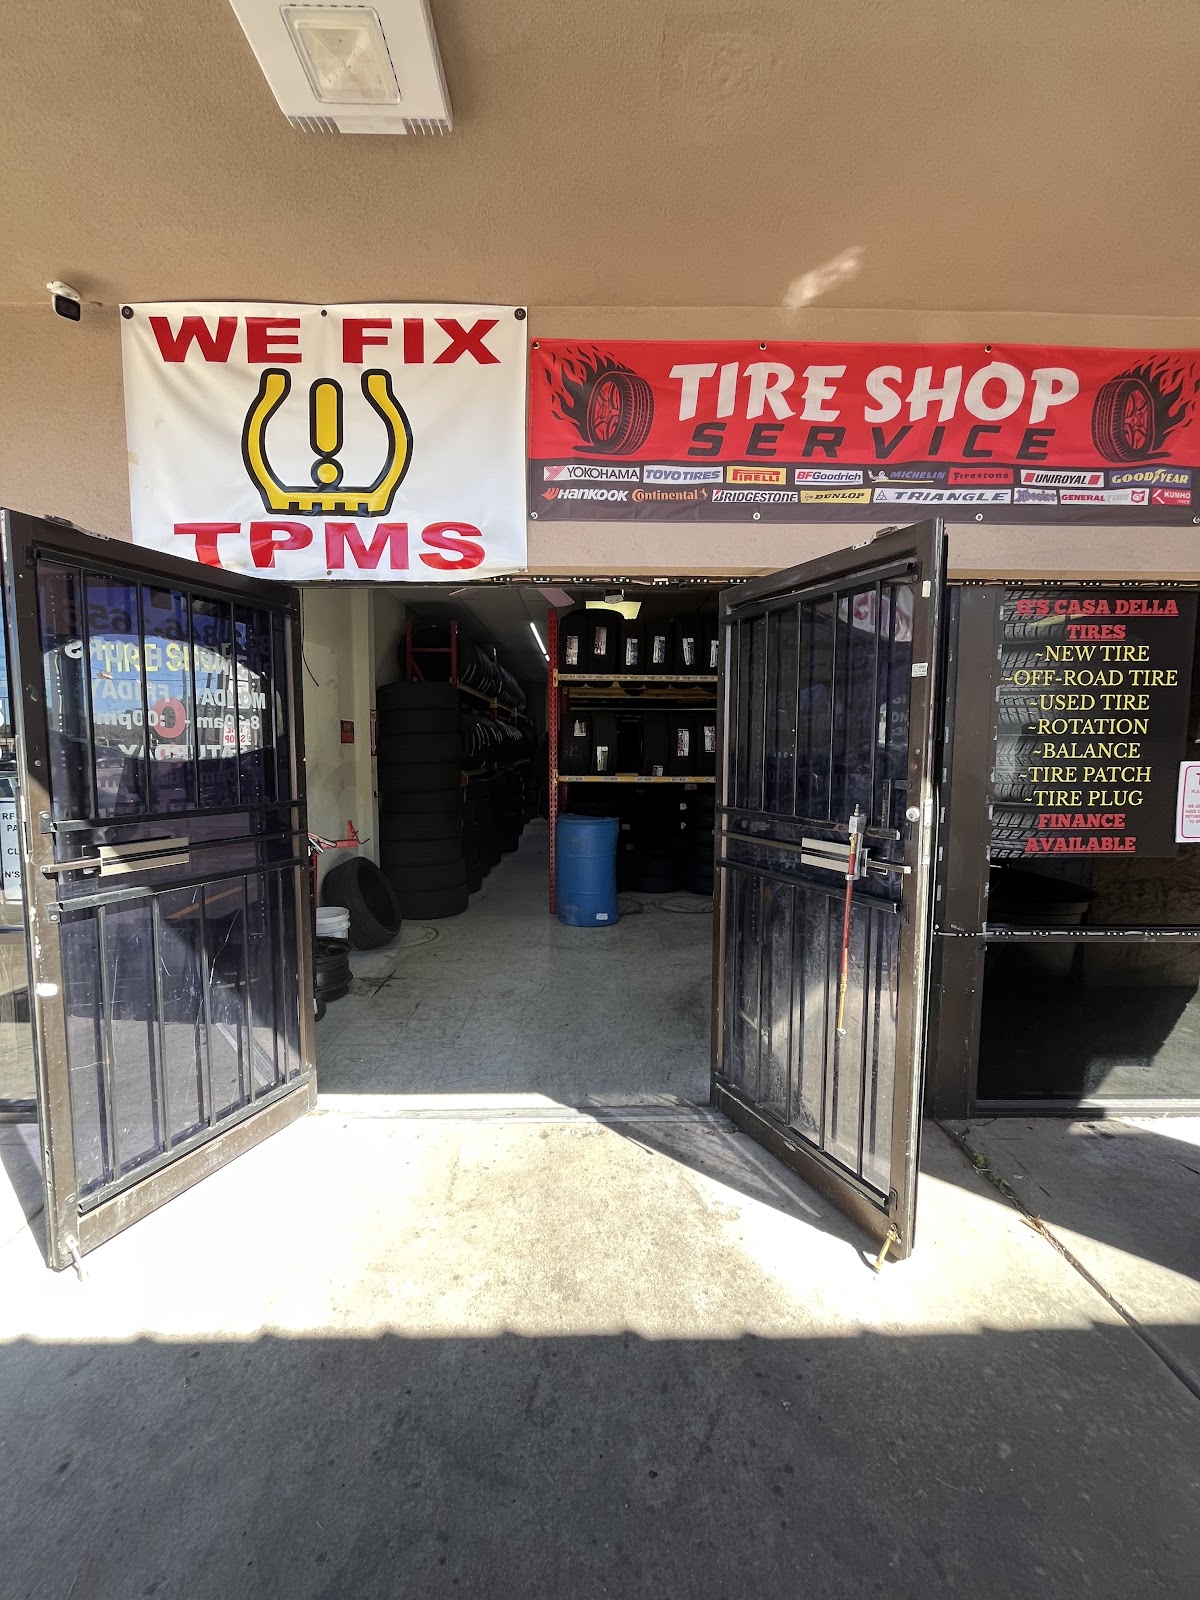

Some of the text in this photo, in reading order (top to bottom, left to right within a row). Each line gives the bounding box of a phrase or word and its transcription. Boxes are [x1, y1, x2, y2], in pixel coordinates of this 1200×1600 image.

[148, 315, 501, 365] WE FIX
[668, 360, 1080, 425] TIRE SHOP
[686, 421, 1056, 461] SERVICE
[566, 466, 640, 480] YOKOHAMA
[645, 468, 721, 481] TOYO TIRES
[732, 468, 782, 482] PIRELLI
[796, 470, 862, 482] BFGoodrich
[889, 470, 947, 480] MICHELIN
[953, 471, 1009, 481] Firestone
[1034, 473, 1088, 485] UNIROYAL
[1111, 468, 1190, 484] GOODYEAR
[631, 487, 699, 502] Continental
[712, 489, 798, 503] BRIDGESTONE
[813, 491, 866, 501] DUNLOP
[894, 491, 1010, 502] TRIANGLE
[1061, 493, 1106, 502] GENERAL
[1163, 490, 1191, 499] KUMHO
[173, 521, 487, 570] TPMS
[1053, 599, 1112, 616] CASA
[1115, 599, 1179, 616] DELLA
[1066, 624, 1127, 641] TIRES
[1099, 645, 1150, 662] TIRE
[1128, 669, 1179, 687] TIRE
[1099, 694, 1150, 711] TIRE
[1082, 766, 1152, 783] PATCH
[1087, 790, 1144, 806] PLUG
[1037, 813, 1126, 829] FINANCE
[1024, 836, 1137, 853] AVAILABLE
